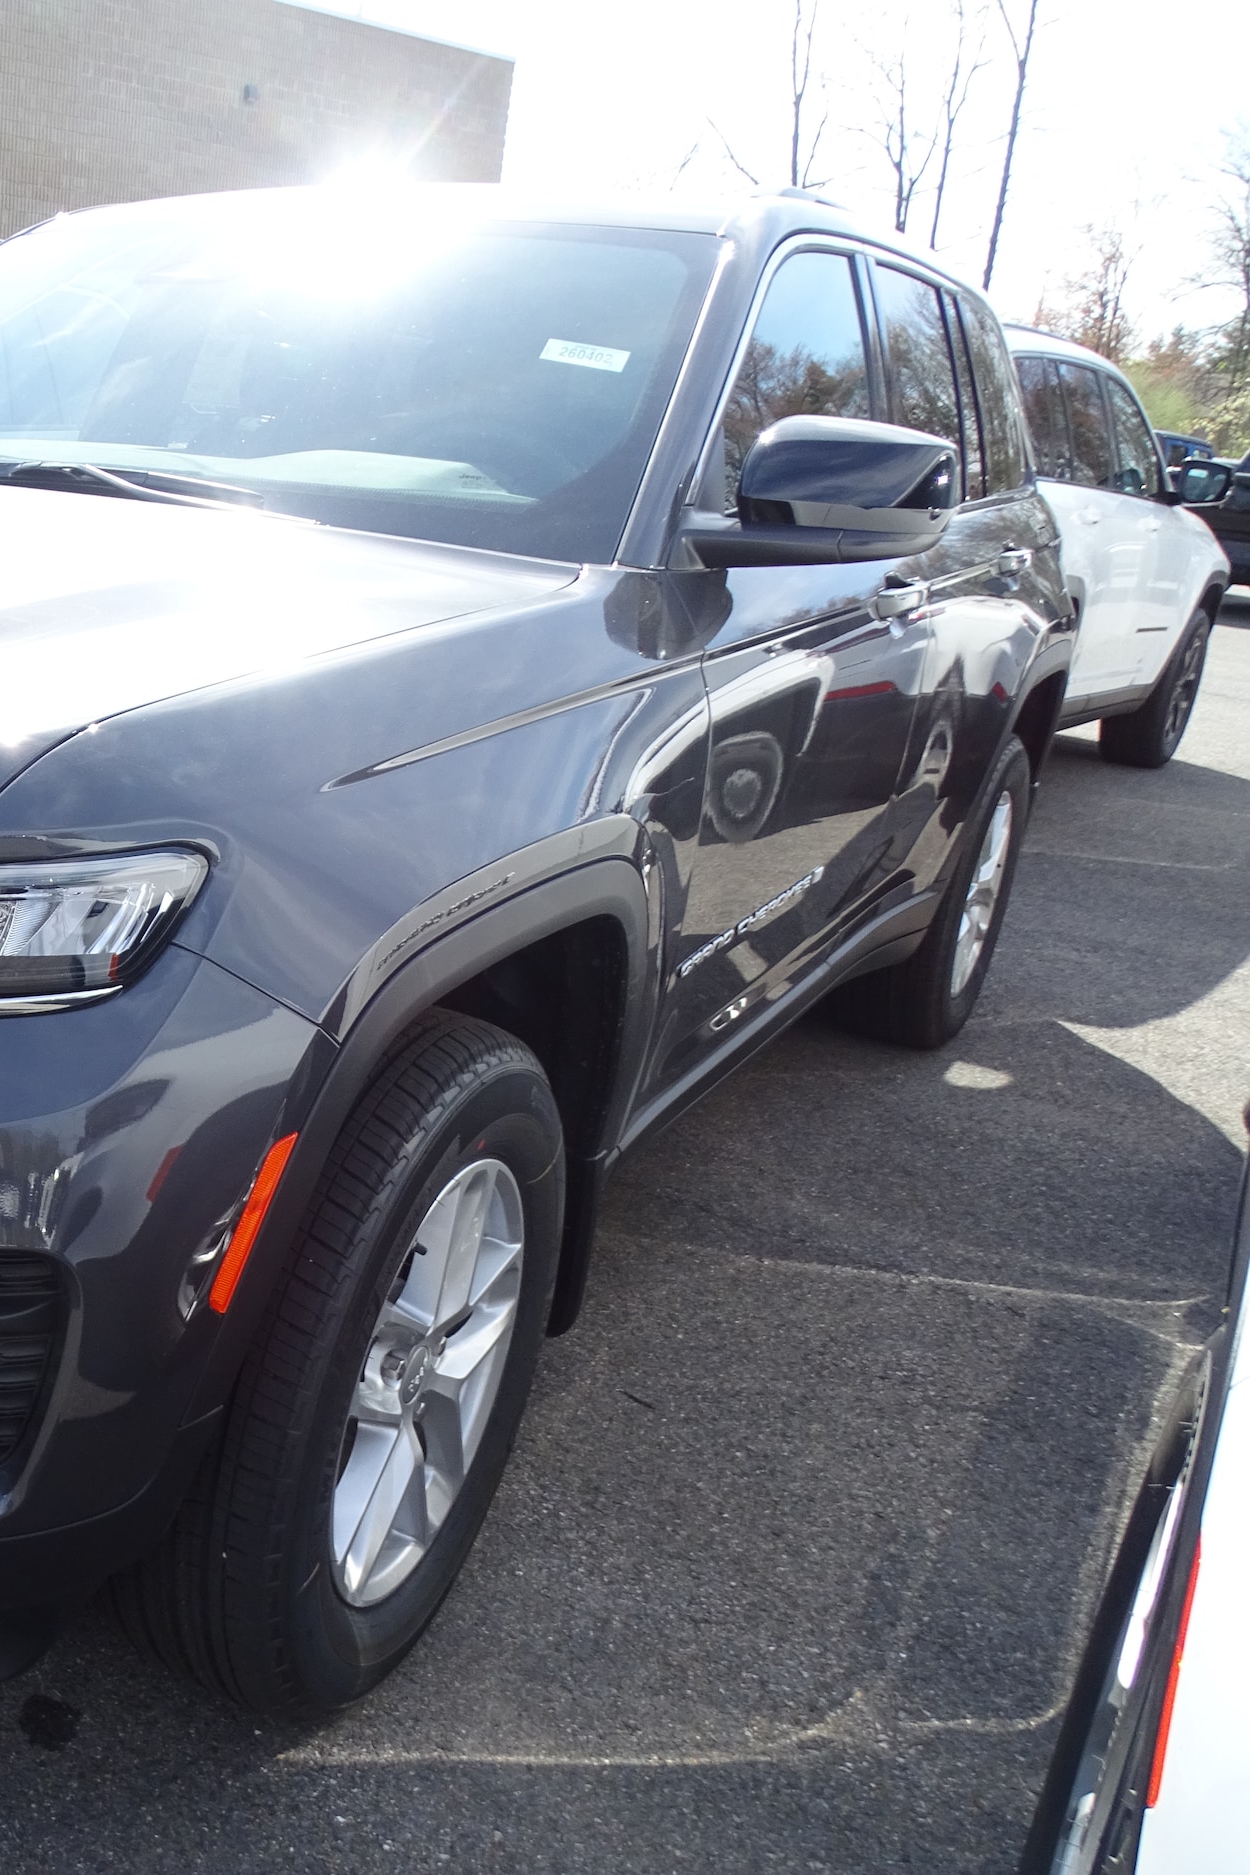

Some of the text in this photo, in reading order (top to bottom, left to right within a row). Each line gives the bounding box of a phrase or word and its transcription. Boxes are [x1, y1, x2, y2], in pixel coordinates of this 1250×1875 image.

[558, 346, 613, 364] 260402
[678, 874, 813, 978] GRAND CHEROKEE
